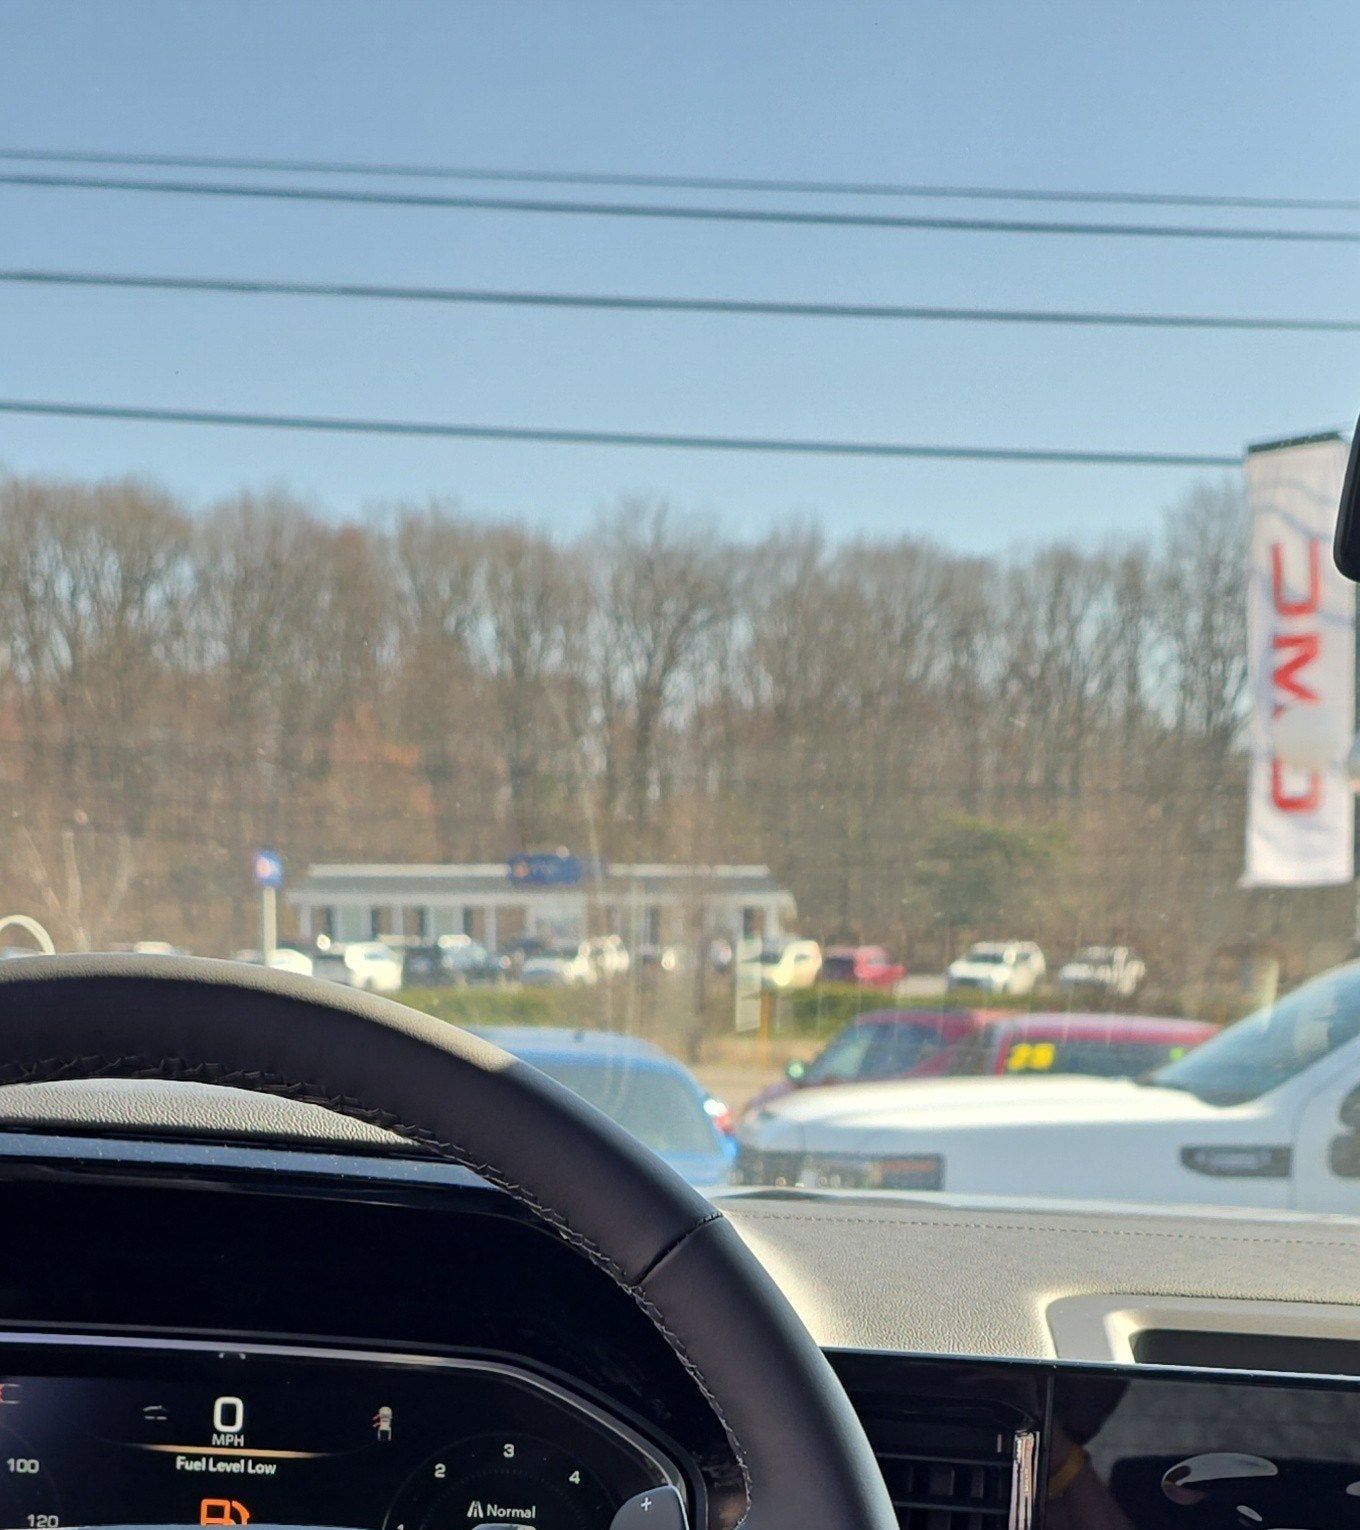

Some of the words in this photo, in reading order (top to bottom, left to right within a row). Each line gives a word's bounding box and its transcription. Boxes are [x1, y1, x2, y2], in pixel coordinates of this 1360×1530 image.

[213, 1396, 244, 1433] 0
[212, 1433, 245, 1448] MPH
[503, 1443, 515, 1458] 3
[6, 1458, 39, 1474] 100
[175, 1455, 206, 1472] Fuel
[208, 1456, 245, 1474] Level
[247, 1459, 277, 1475] Low
[434, 1463, 446, 1478] 2
[569, 1470, 581, 1485] 4
[486, 1504, 536, 1519] Normal
[27, 1514, 59, 1528] 120
